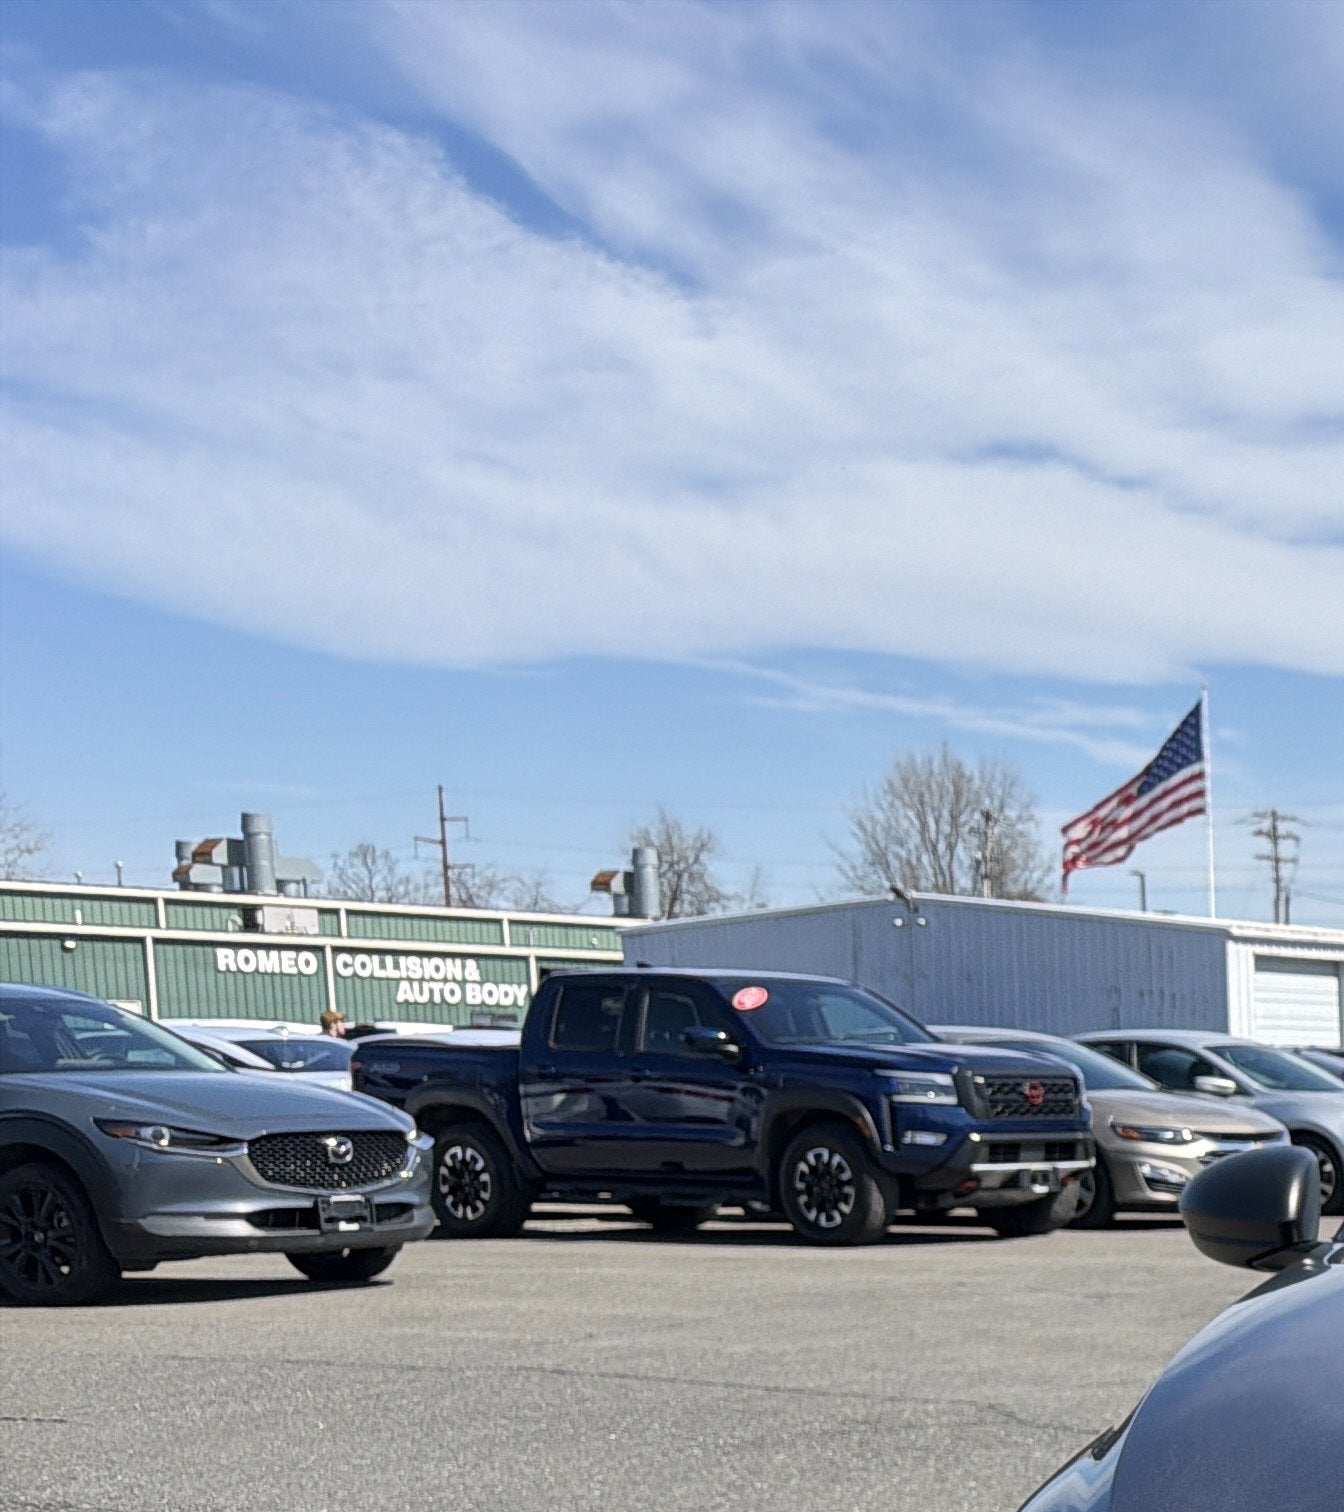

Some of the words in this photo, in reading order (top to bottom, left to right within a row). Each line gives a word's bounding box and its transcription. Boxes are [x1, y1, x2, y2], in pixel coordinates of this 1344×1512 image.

[215, 948, 318, 975] ROMEO
[335, 953, 462, 981] COLLISION
[464, 958, 481, 982] &
[396, 981, 462, 1004] AUTO
[465, 982, 528, 1007] BODY
